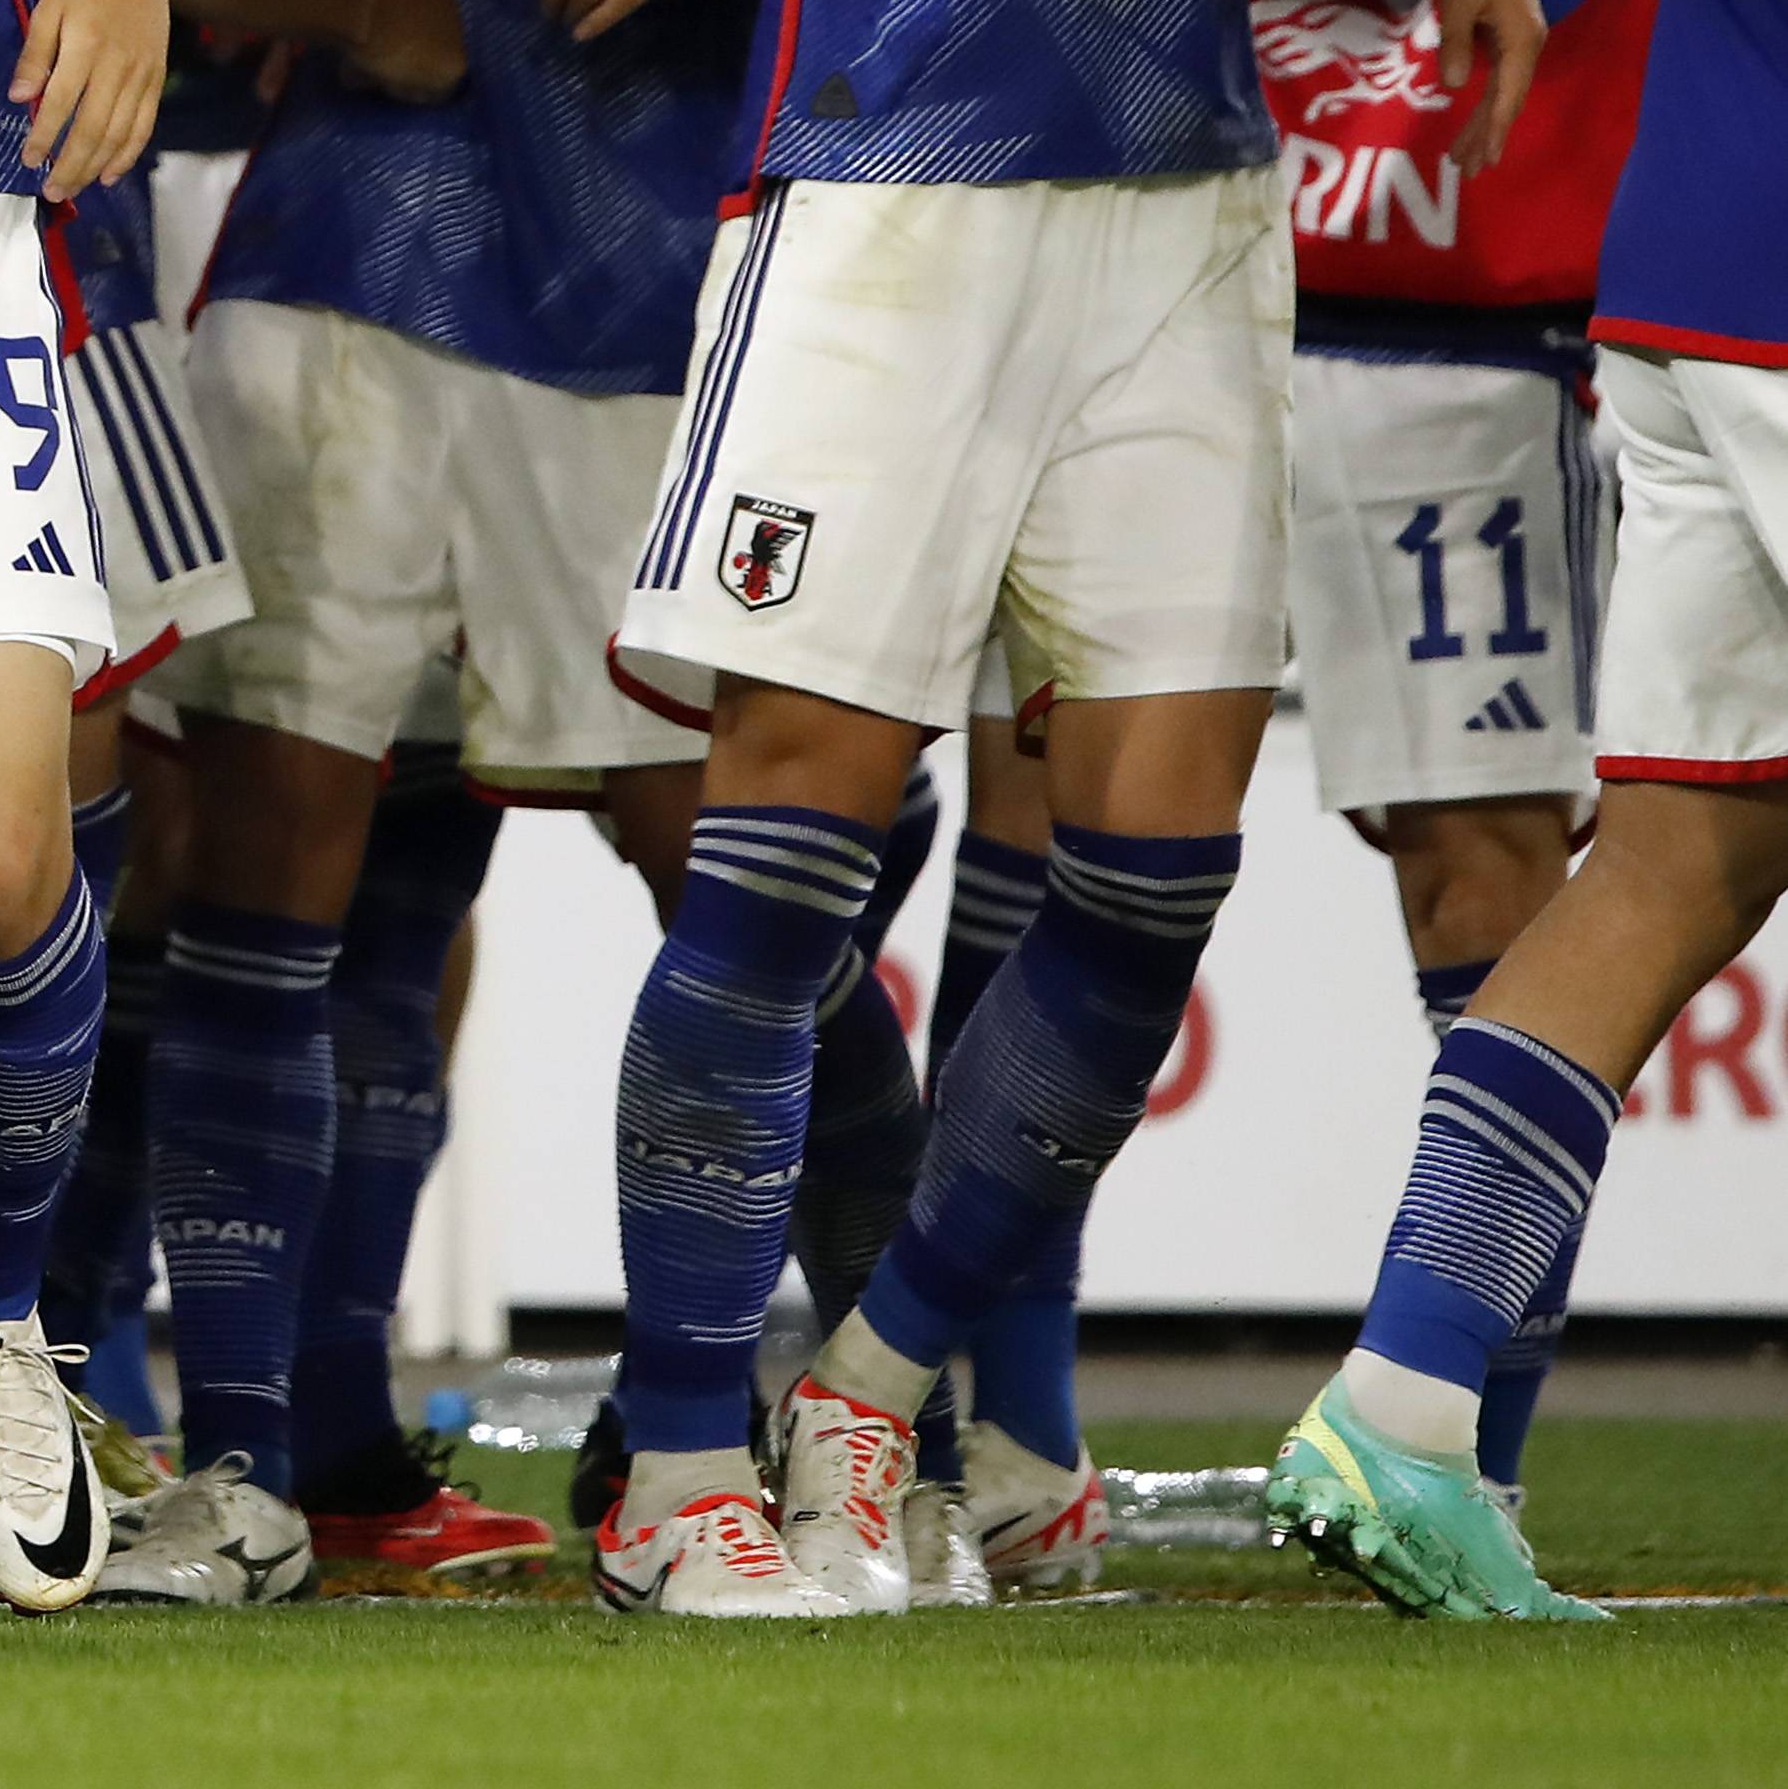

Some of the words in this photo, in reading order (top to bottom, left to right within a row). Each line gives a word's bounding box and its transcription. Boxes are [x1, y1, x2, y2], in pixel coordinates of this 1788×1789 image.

[1283, 133, 1460, 248] RIN
[751, 500, 798, 519] JAPAN
[1397, 496, 1548, 661] 11
[156, 1217, 286, 1250] APAN
